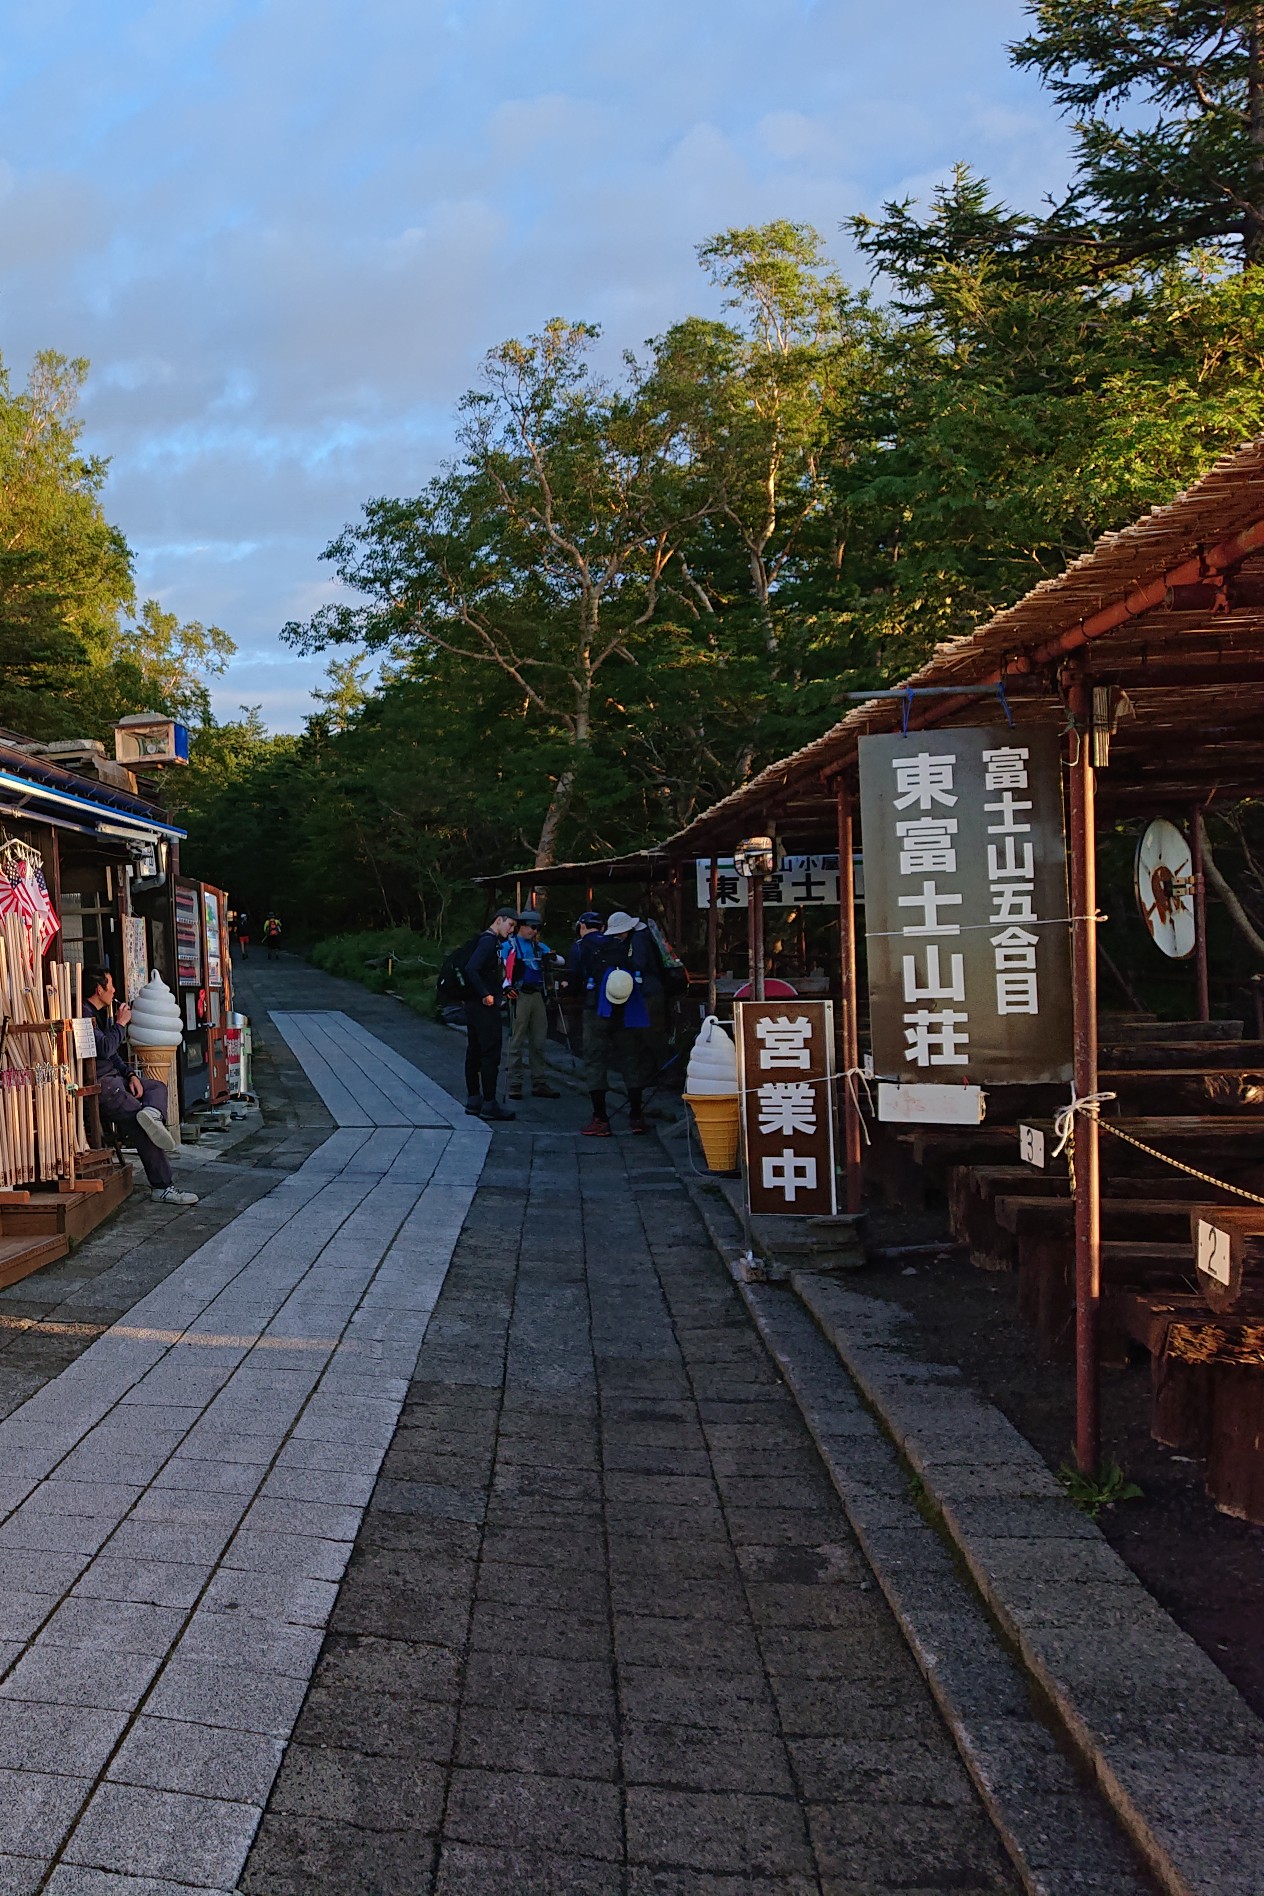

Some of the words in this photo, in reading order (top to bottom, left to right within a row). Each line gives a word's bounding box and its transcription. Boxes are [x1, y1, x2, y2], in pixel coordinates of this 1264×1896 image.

[892, 752, 970, 1067] 東富士山荘
[982, 747, 1039, 1015] 富士山五合目
[756, 1016, 817, 1201] 営業中
[1026, 1128, 1034, 1162] 3
[1208, 1226, 1218, 1276] 2
